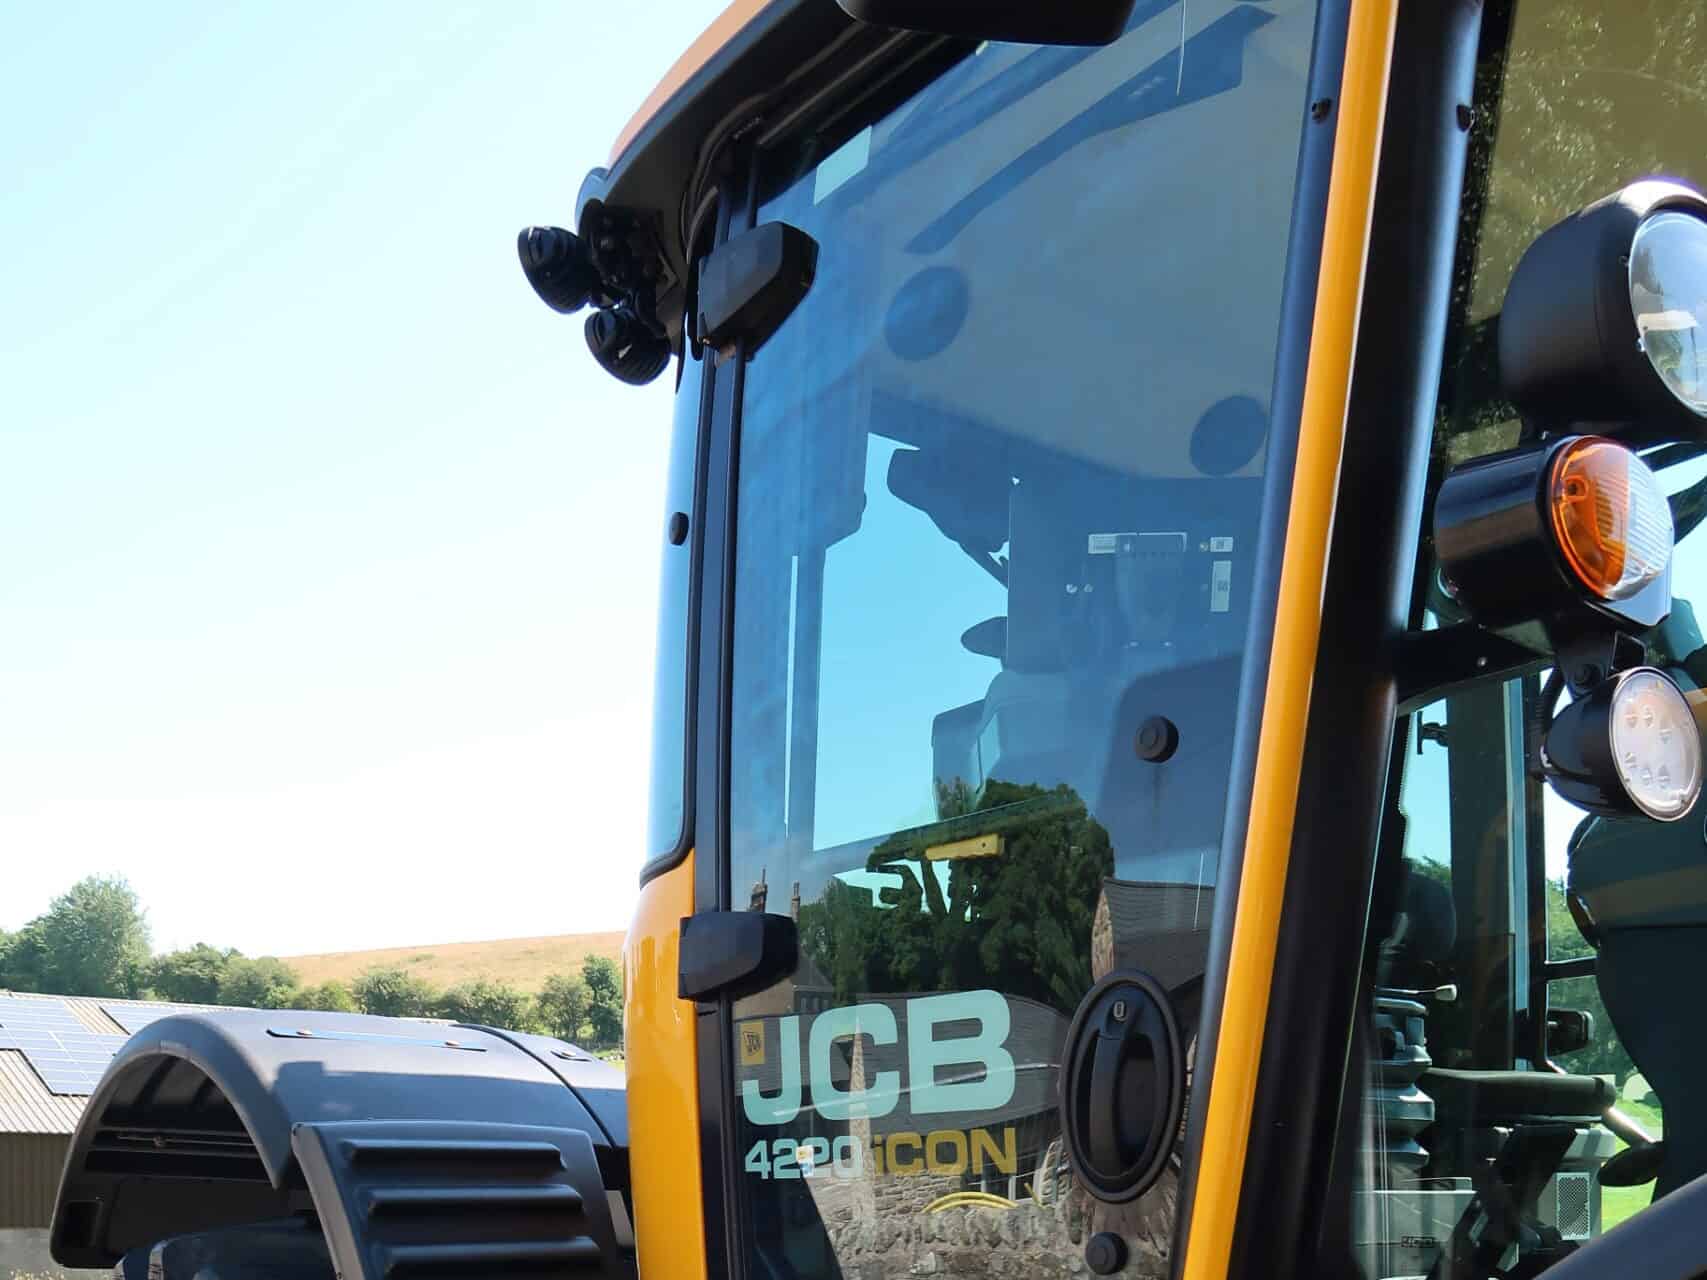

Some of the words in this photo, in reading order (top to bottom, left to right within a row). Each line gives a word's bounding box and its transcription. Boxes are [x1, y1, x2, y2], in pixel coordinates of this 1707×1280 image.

[742, 989, 1016, 1125] JCB
[744, 1136, 863, 1180] 4220
[874, 1128, 1018, 1177] iCON
